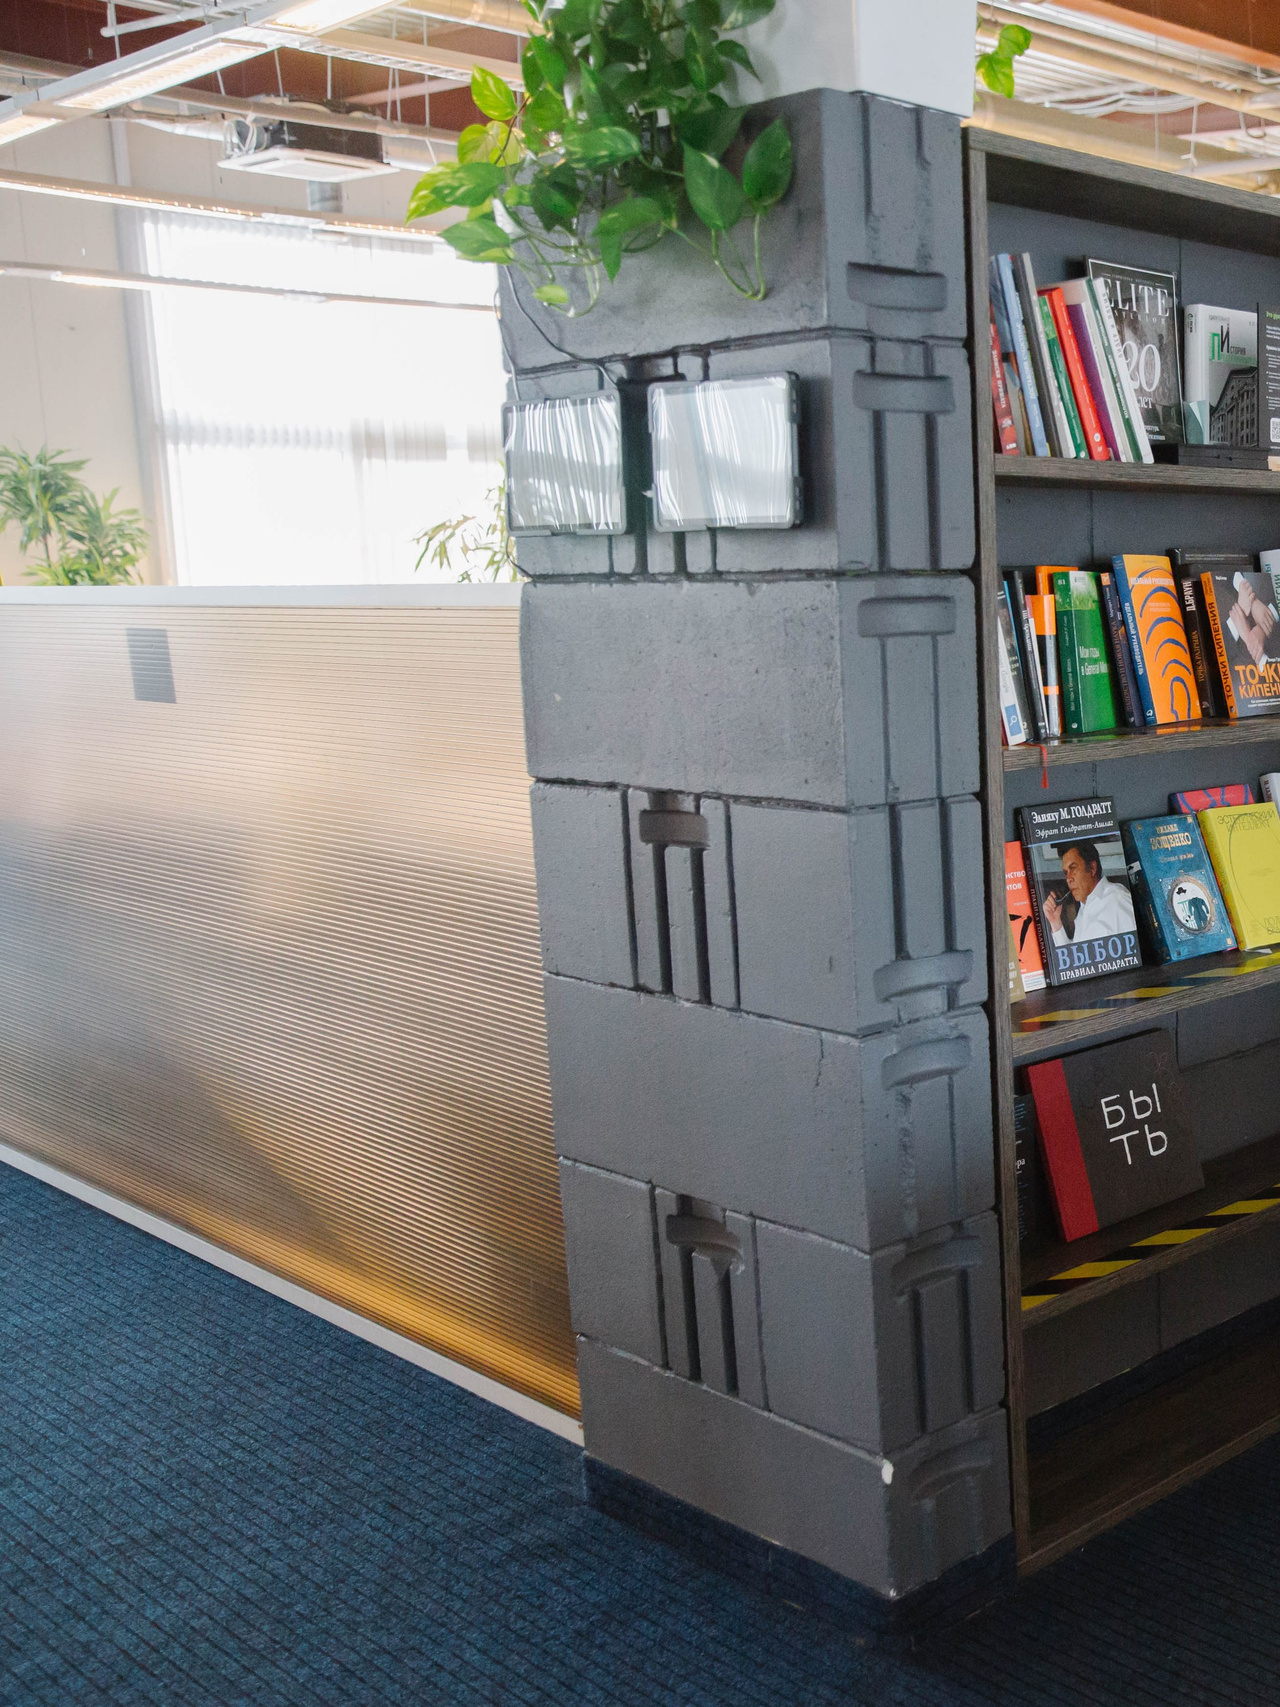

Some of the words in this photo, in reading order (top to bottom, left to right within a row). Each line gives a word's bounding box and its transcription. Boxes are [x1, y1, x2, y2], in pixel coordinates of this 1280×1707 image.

[1122, 341, 1160, 392] 20
[1182, 581, 1197, 612] Д.БРАУН
[1124, 602, 1136, 635] ИДЕАЛЬНЫЙ
[1132, 635, 1144, 676] РУКОВОДИТЕЛЬ
[1208, 602, 1225, 660] КИПЕНИЯ
[1218, 661, 1232, 698] ТОЧКИ
[1032, 811, 1060, 825] Элияху
[1060, 808, 1070, 820] М.
[1071, 802, 1112, 818] ГОЛДРАТТ
[1035, 827, 1058, 838] Эфрат
[1060, 820, 1114, 834] Голдратт-Ашлаг
[1150, 832, 1192, 850] ЗОЩЕНКО
[1030, 888, 1040, 921] ПРАВИЛА
[1036, 923, 1047, 964] ГОЛДРАТТА
[1056, 934, 1137, 970] ВЫБОР.
[1060, 966, 1096, 981] ПРАВИЛА
[1098, 957, 1138, 973] ГОЛДРАТТА
[1100, 1083, 1161, 1129] БЫ
[1110, 1124, 1168, 1165] ТЬ
